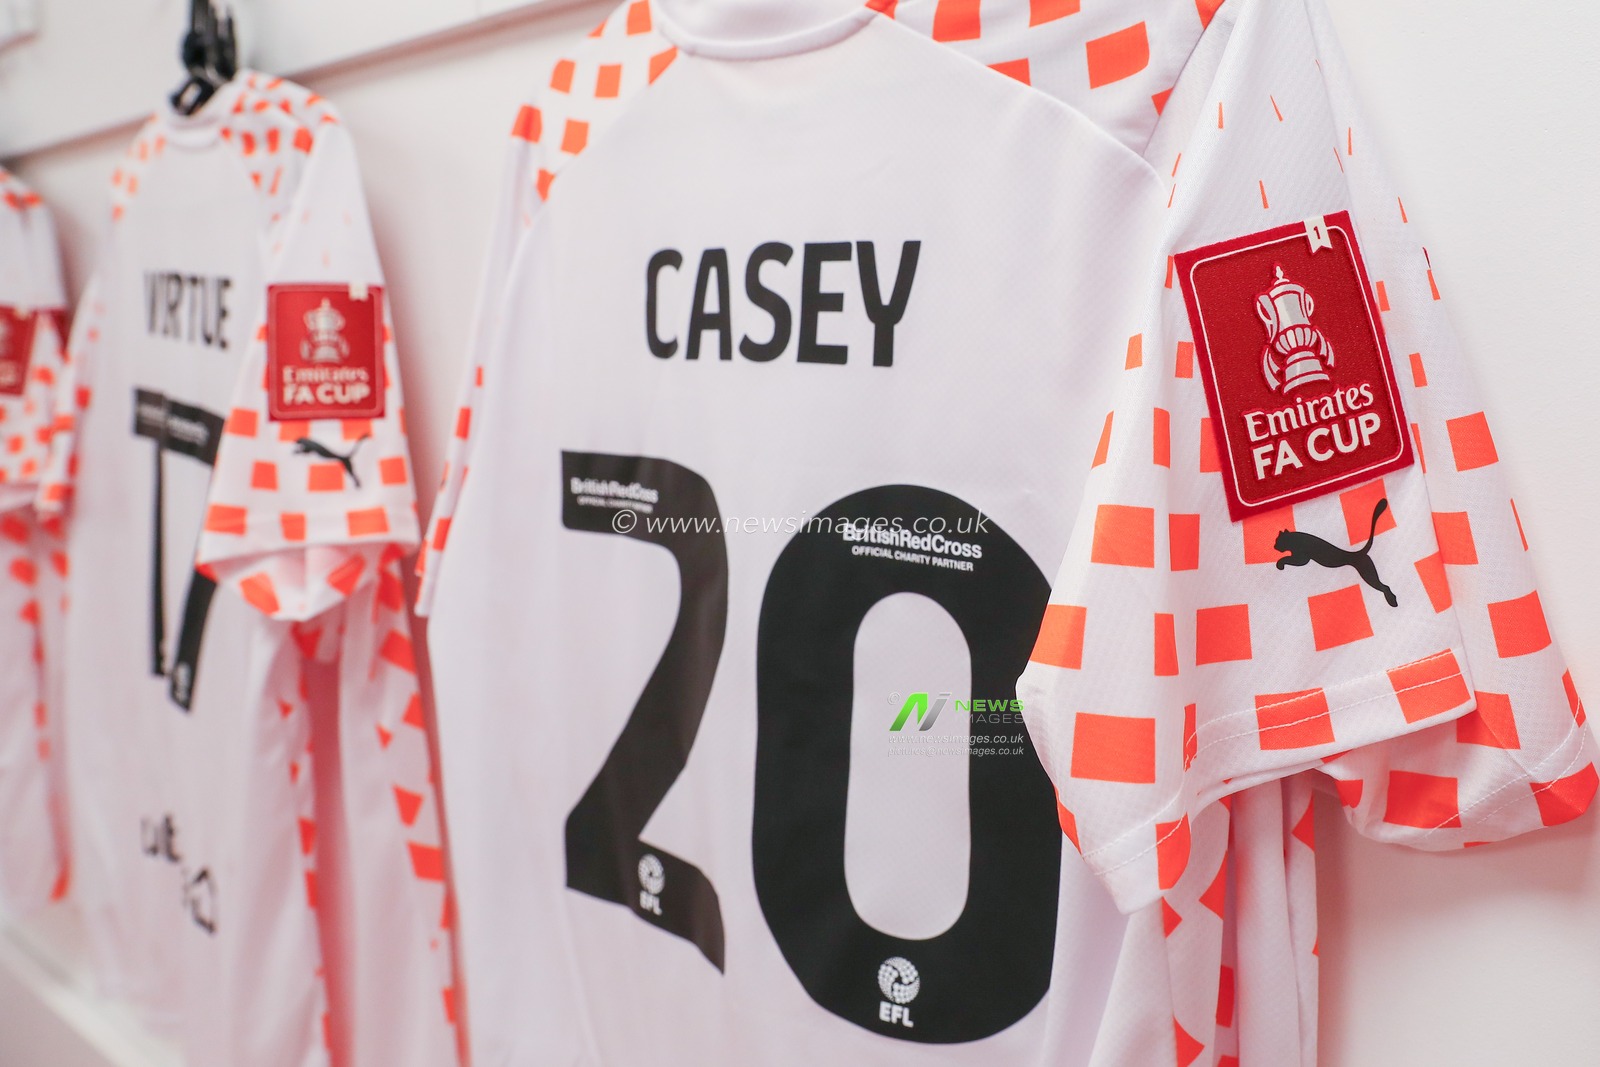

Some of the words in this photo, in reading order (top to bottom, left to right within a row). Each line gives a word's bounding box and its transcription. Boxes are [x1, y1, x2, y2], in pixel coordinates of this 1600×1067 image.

[1313, 225, 1321, 240] 1
[143, 272, 232, 351] VIRTUE
[646, 240, 921, 367] CASEY
[283, 365, 369, 383] Emirates
[283, 384, 315, 406] FA
[316, 382, 371, 405] CUP
[1244, 383, 1374, 442] Emirates
[1252, 439, 1304, 480] FA
[1306, 412, 1381, 462] CUP
[851, 545, 893, 559] OFFICIAL
[894, 550, 931, 565] CHARITY
[931, 557, 974, 572] PARTNER
[560, 449, 1062, 1045] 20
[638, 890, 663, 916] EFL
[878, 1001, 914, 1028] EFL
